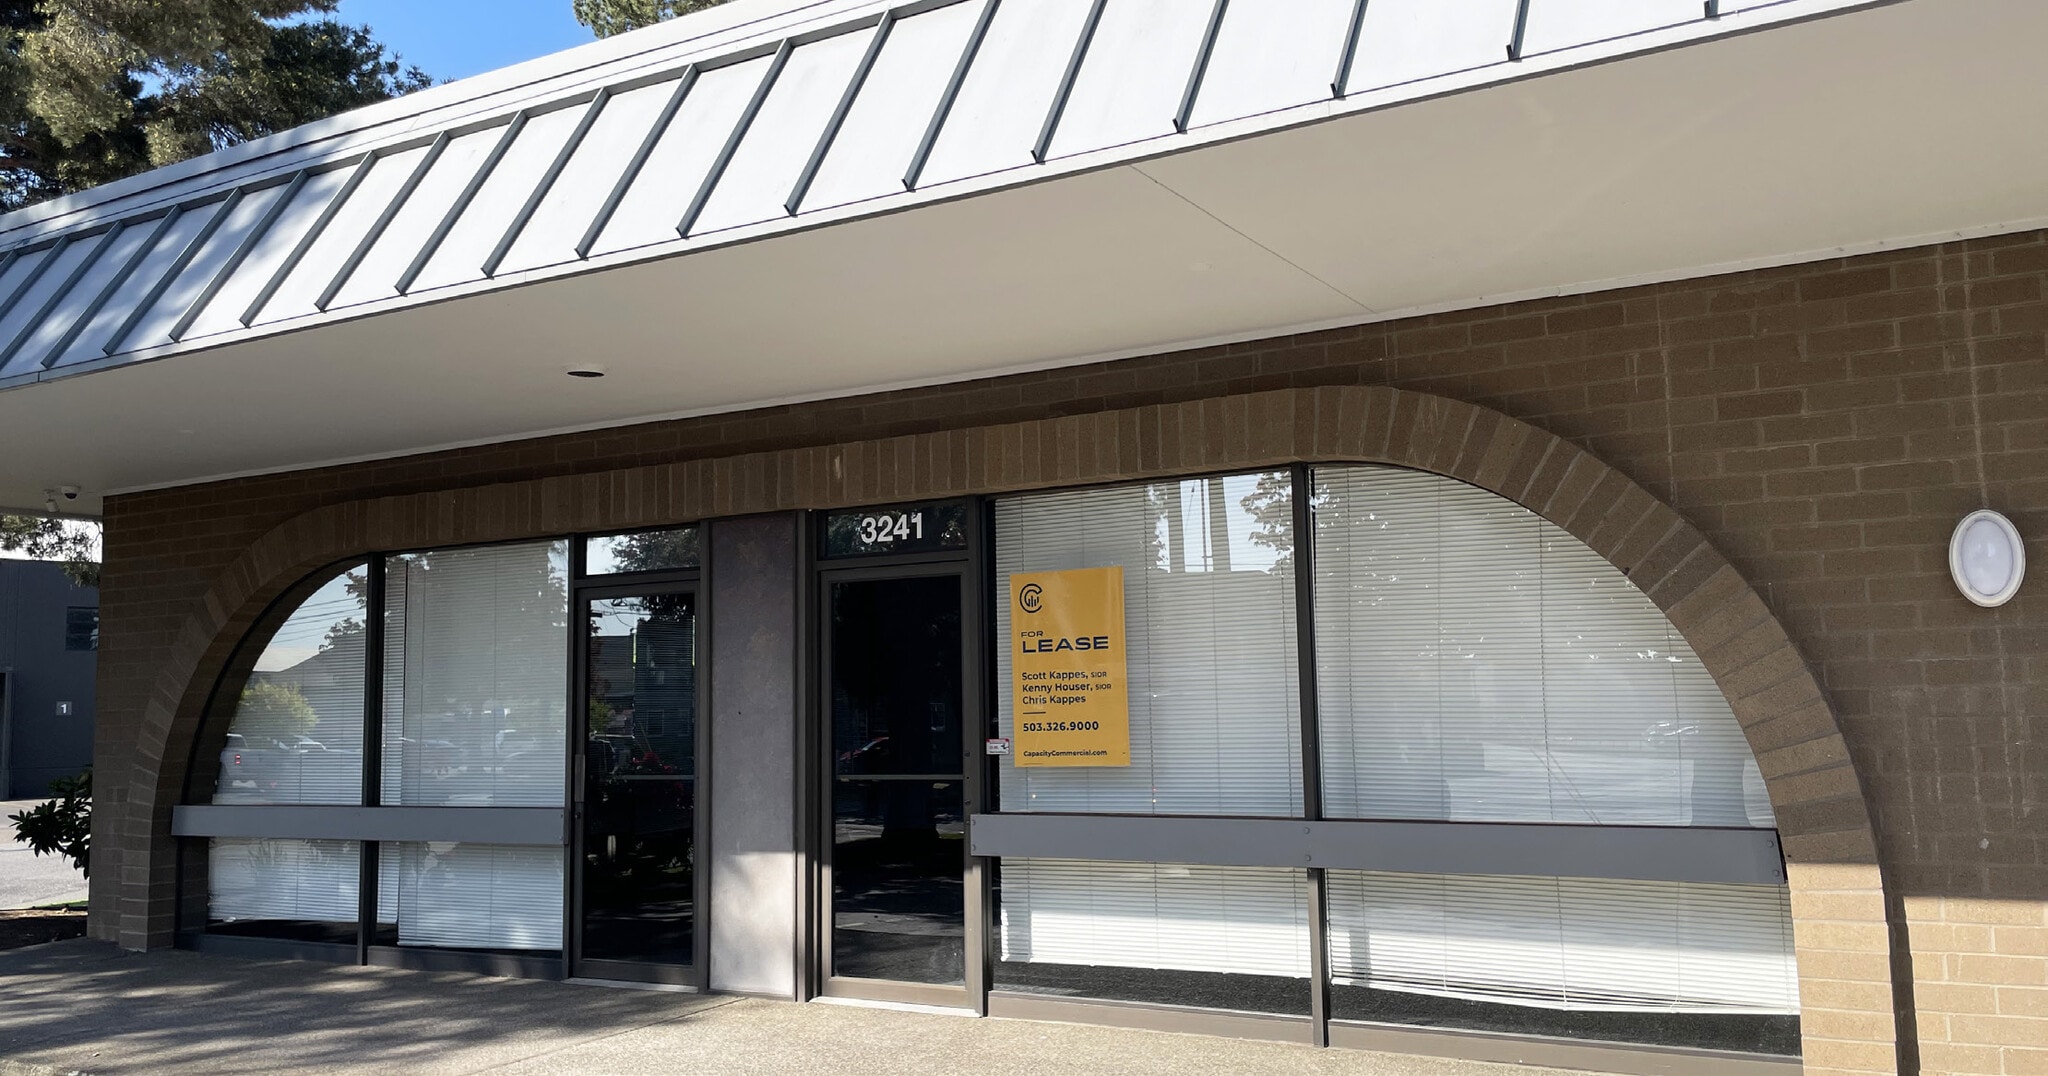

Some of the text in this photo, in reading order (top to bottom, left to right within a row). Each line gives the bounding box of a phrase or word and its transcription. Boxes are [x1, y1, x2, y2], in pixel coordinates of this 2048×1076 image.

[861, 512, 922, 544] 3241
[1020, 630, 1044, 638] FOR
[1022, 636, 1109, 654] LEASE
[1021, 672, 1047, 681] Scott
[1049, 671, 1089, 681] Kappes,
[1022, 683, 1112, 694] Kenny Houser, SIOR
[1022, 695, 1087, 705] Chris Kappes
[60, 703, 67, 714] 1
[1022, 721, 1099, 732] 503.326.9000
[1023, 749, 1108, 758] CapacityCommercial.com
